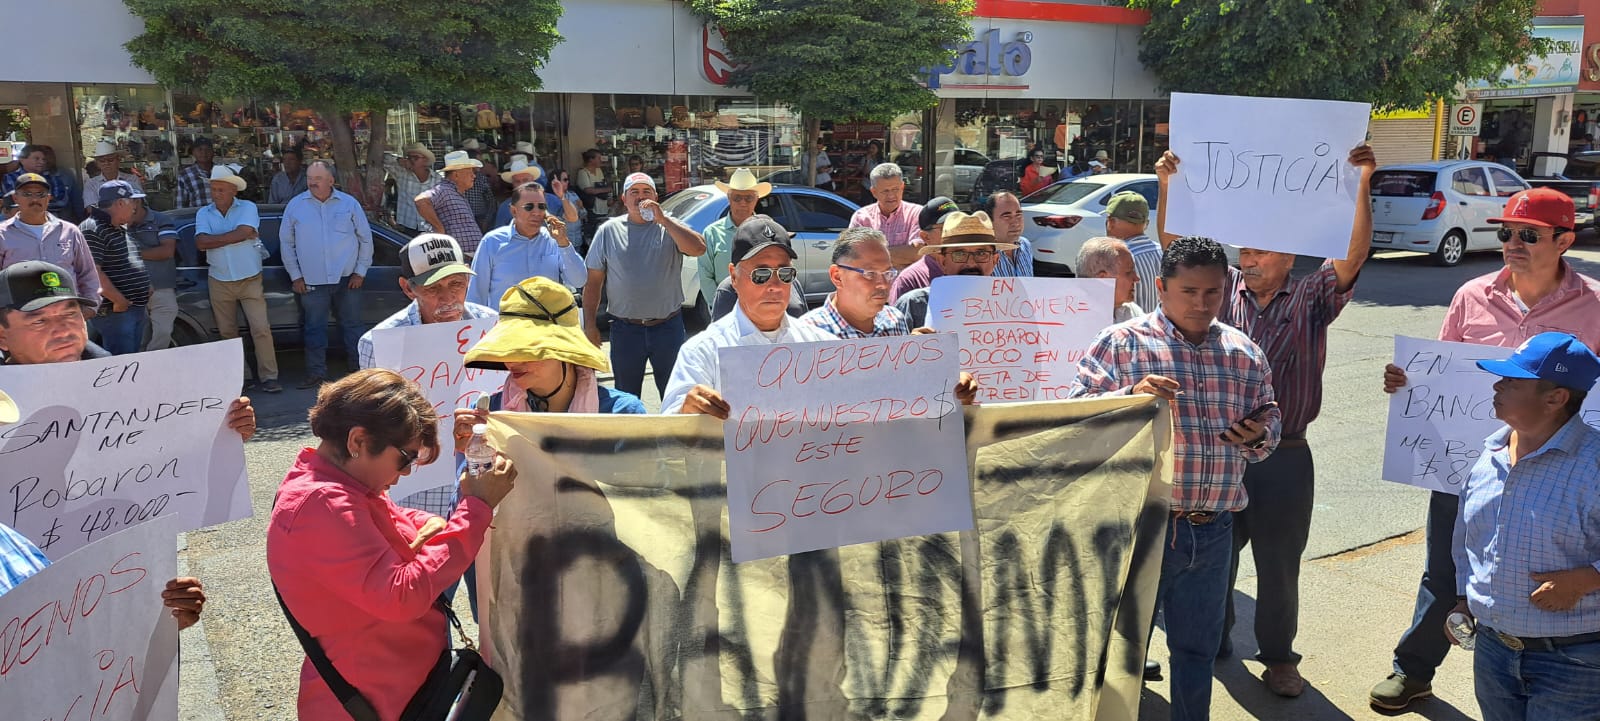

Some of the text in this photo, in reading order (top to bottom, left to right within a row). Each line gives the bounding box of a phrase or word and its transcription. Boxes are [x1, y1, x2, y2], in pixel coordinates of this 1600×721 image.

[1461, 109, 1471, 121] E
[1184, 141, 1339, 194] JUSTICIA
[992, 279, 1015, 296] EN
[969, 328, 1050, 348] ROBARON
[757, 339, 943, 389] QUEREMOS
[1033, 350, 1059, 363] EN
[1405, 351, 1453, 375] EN
[1022, 370, 1052, 383] DE
[0, 397, 225, 454] SANTANDER
[98, 429, 146, 452] ME
[1400, 434, 1434, 453] ME
[746, 469, 943, 532] SEGURO
